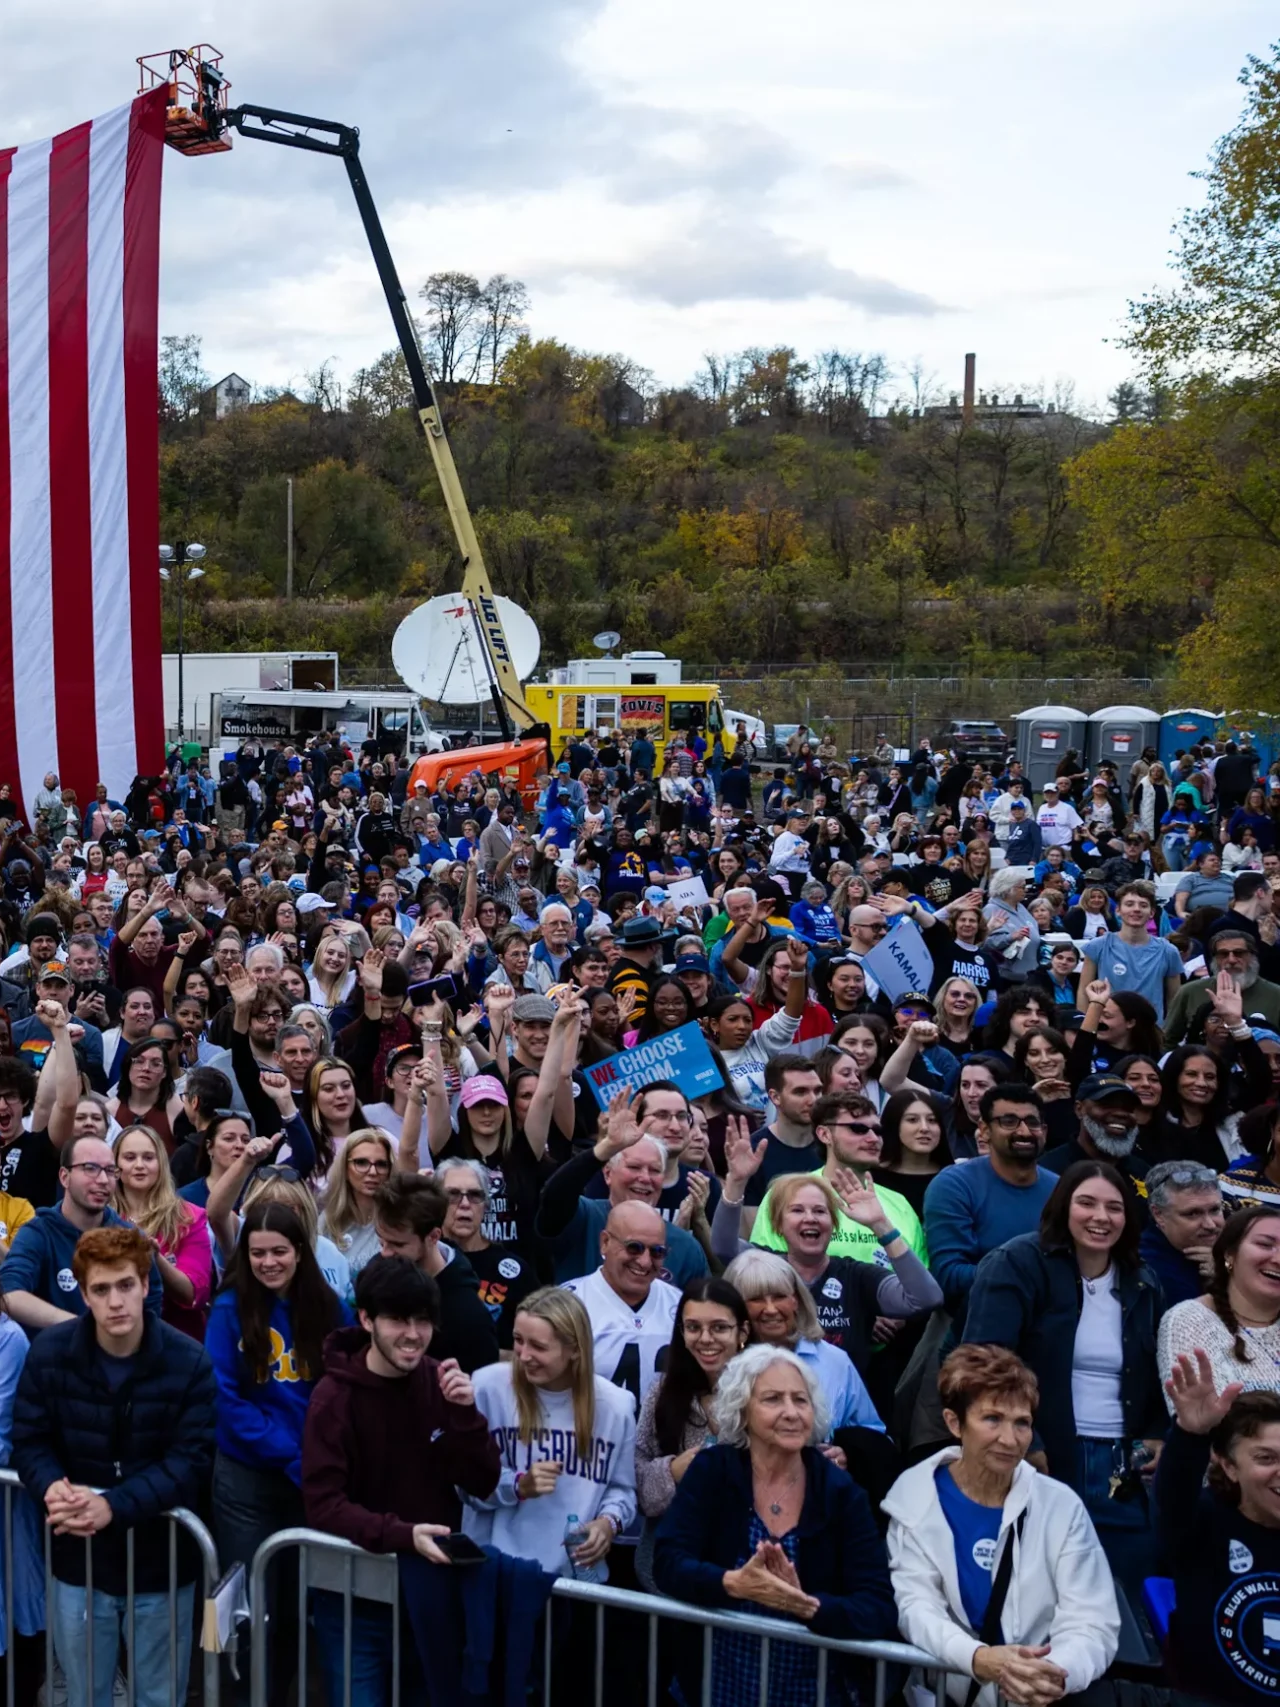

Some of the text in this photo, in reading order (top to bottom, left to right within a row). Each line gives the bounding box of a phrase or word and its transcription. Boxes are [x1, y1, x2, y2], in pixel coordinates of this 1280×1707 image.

[478, 595, 510, 663] JLG LIFT
[224, 721, 286, 736] Smokehouse
[679, 891, 695, 900] ADA
[590, 1033, 686, 1088] WE CHOOSE
[597, 1059, 681, 1108] FREEDOM.
[1224, 1581, 1279, 1618] BLUE WALL
[1230, 1650, 1277, 1687] HARRIS
